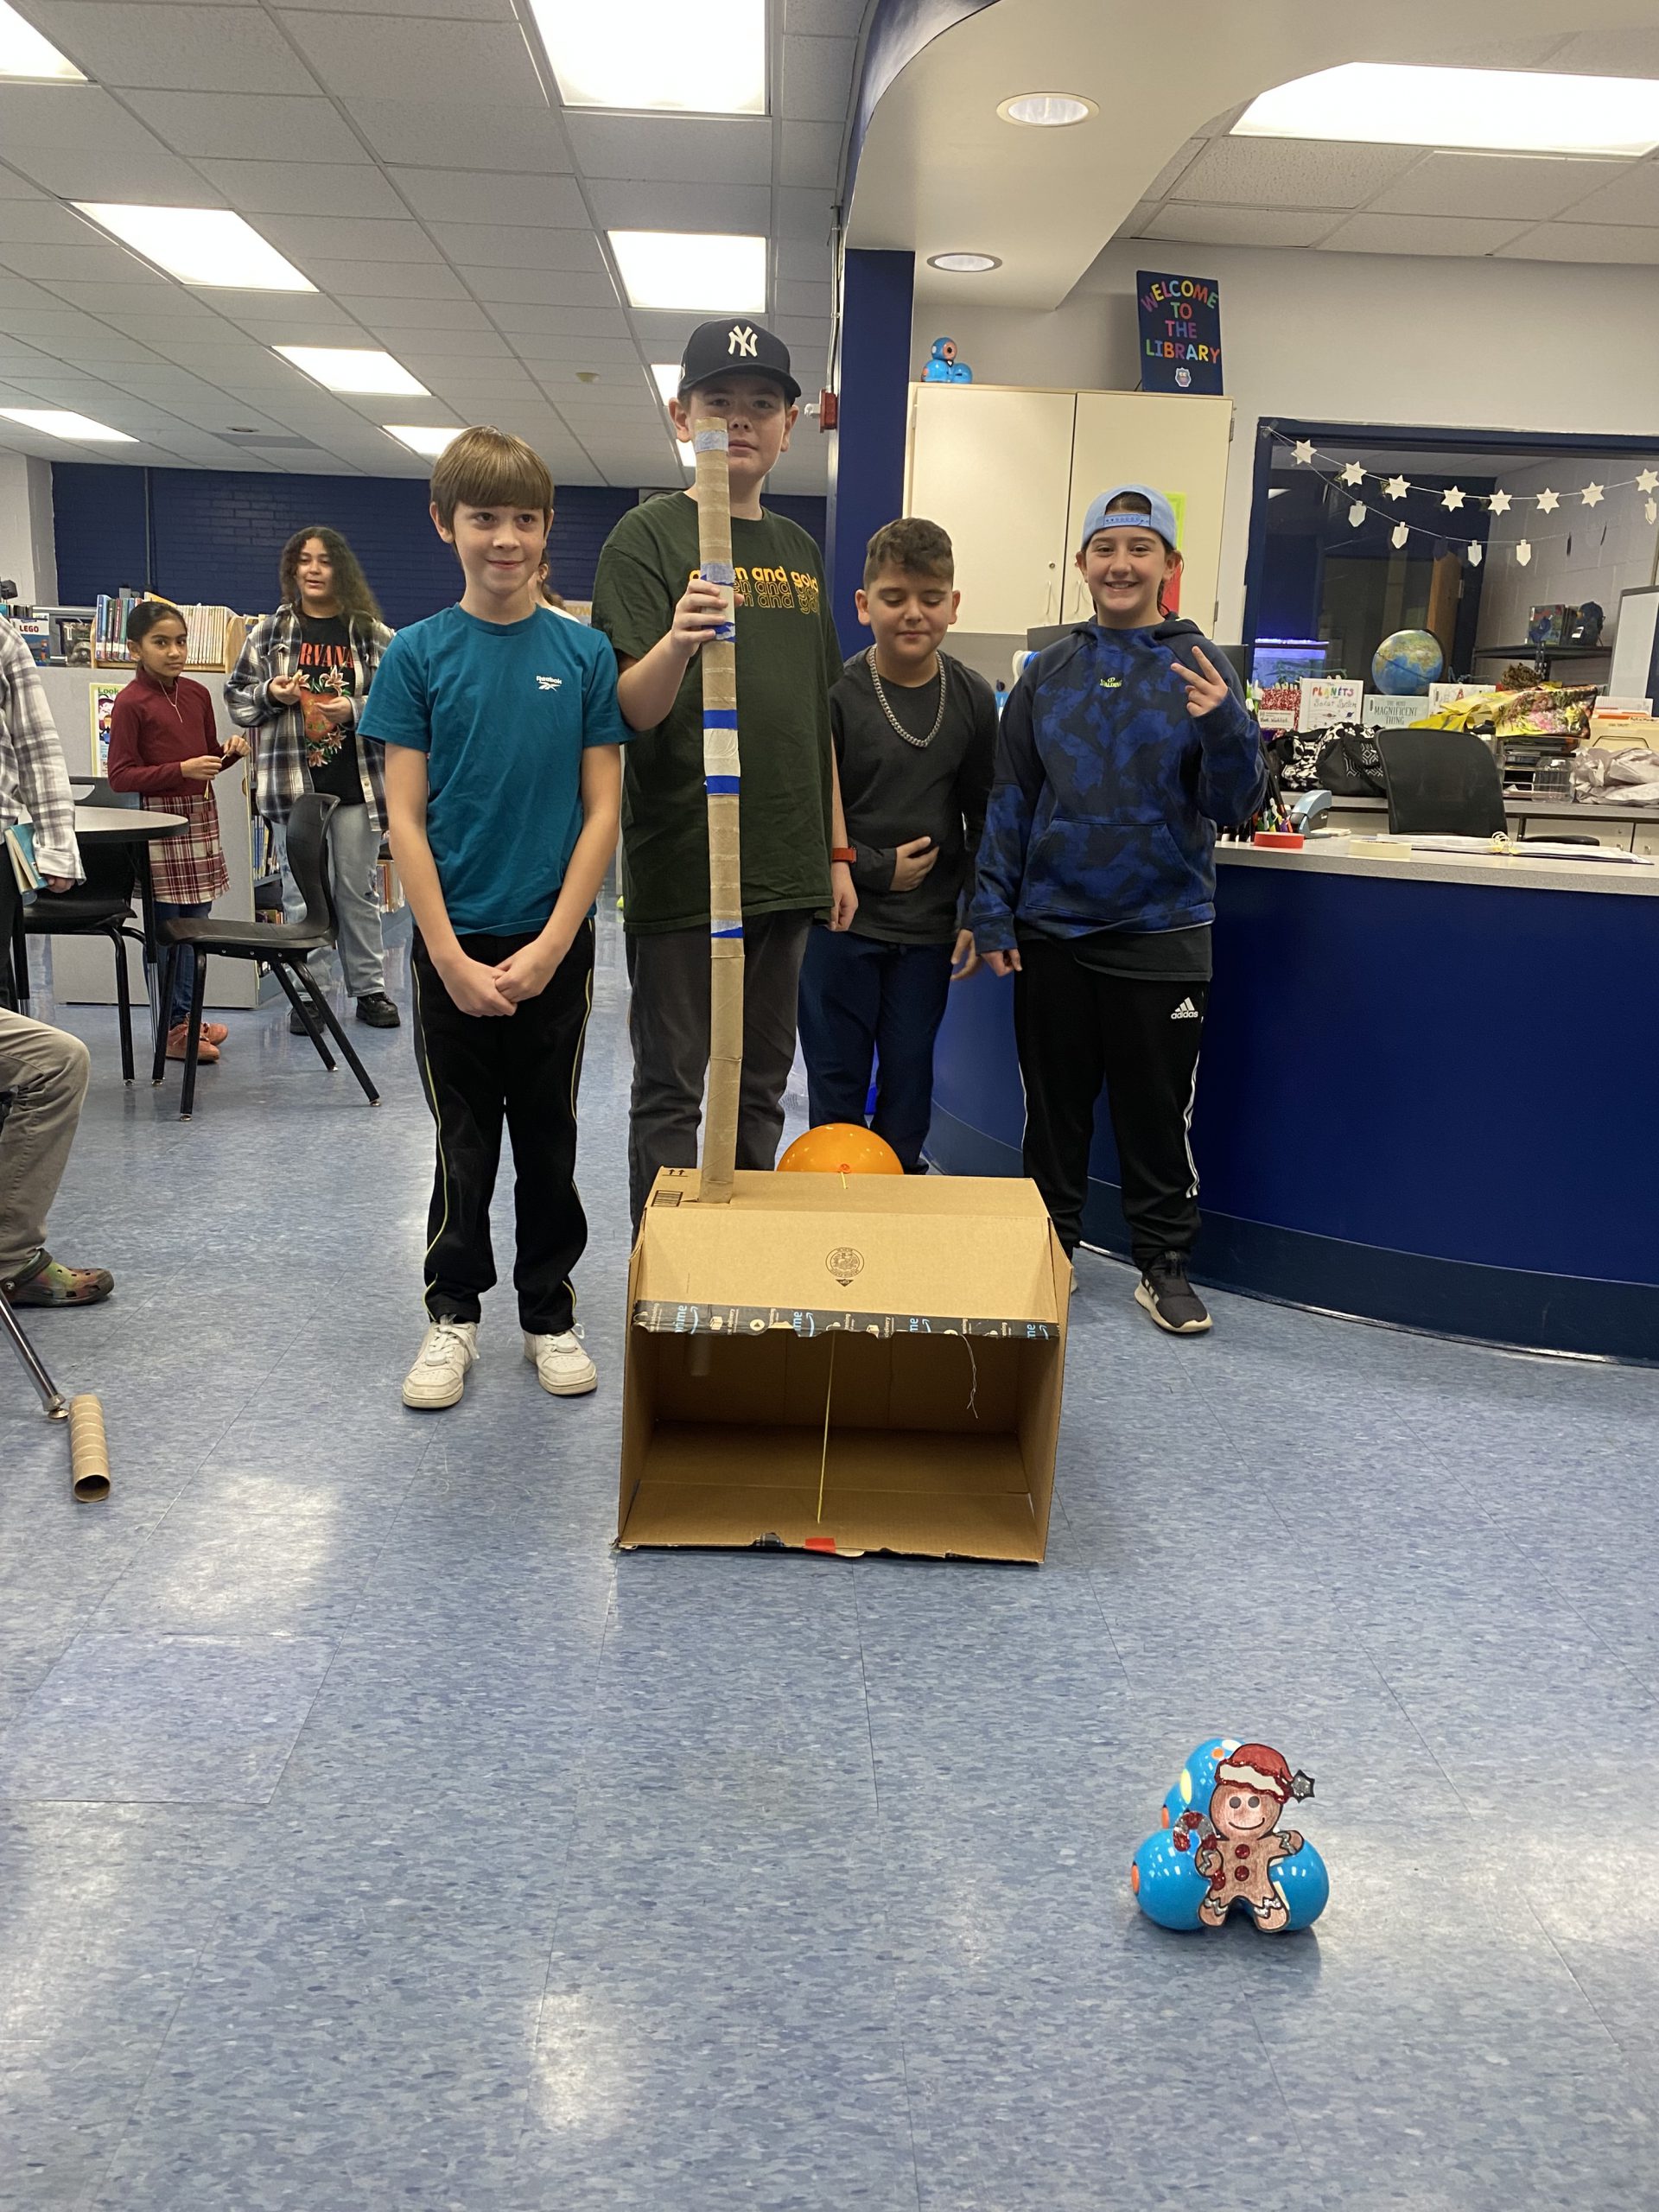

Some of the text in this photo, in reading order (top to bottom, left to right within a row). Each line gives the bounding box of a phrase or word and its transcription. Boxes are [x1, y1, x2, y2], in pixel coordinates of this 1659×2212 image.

[1141, 280, 1218, 312] WELCOME
[1170, 302, 1192, 320] TO
[1165, 320, 1198, 339] THE
[728, 325, 758, 357] NY
[1146, 339, 1220, 364] LIBRARY
[752, 566, 788, 582] and
[790, 570, 819, 593] gold
[754, 580, 791, 595] and
[757, 594, 794, 609] and
[300, 642, 354, 669] RVANA
[1313, 685, 1354, 698] PLANETS
[1374, 706, 1418, 716] MAGNIFICENT
[1385, 716, 1405, 725] THING
[1171, 1011, 1198, 1020] adidas
